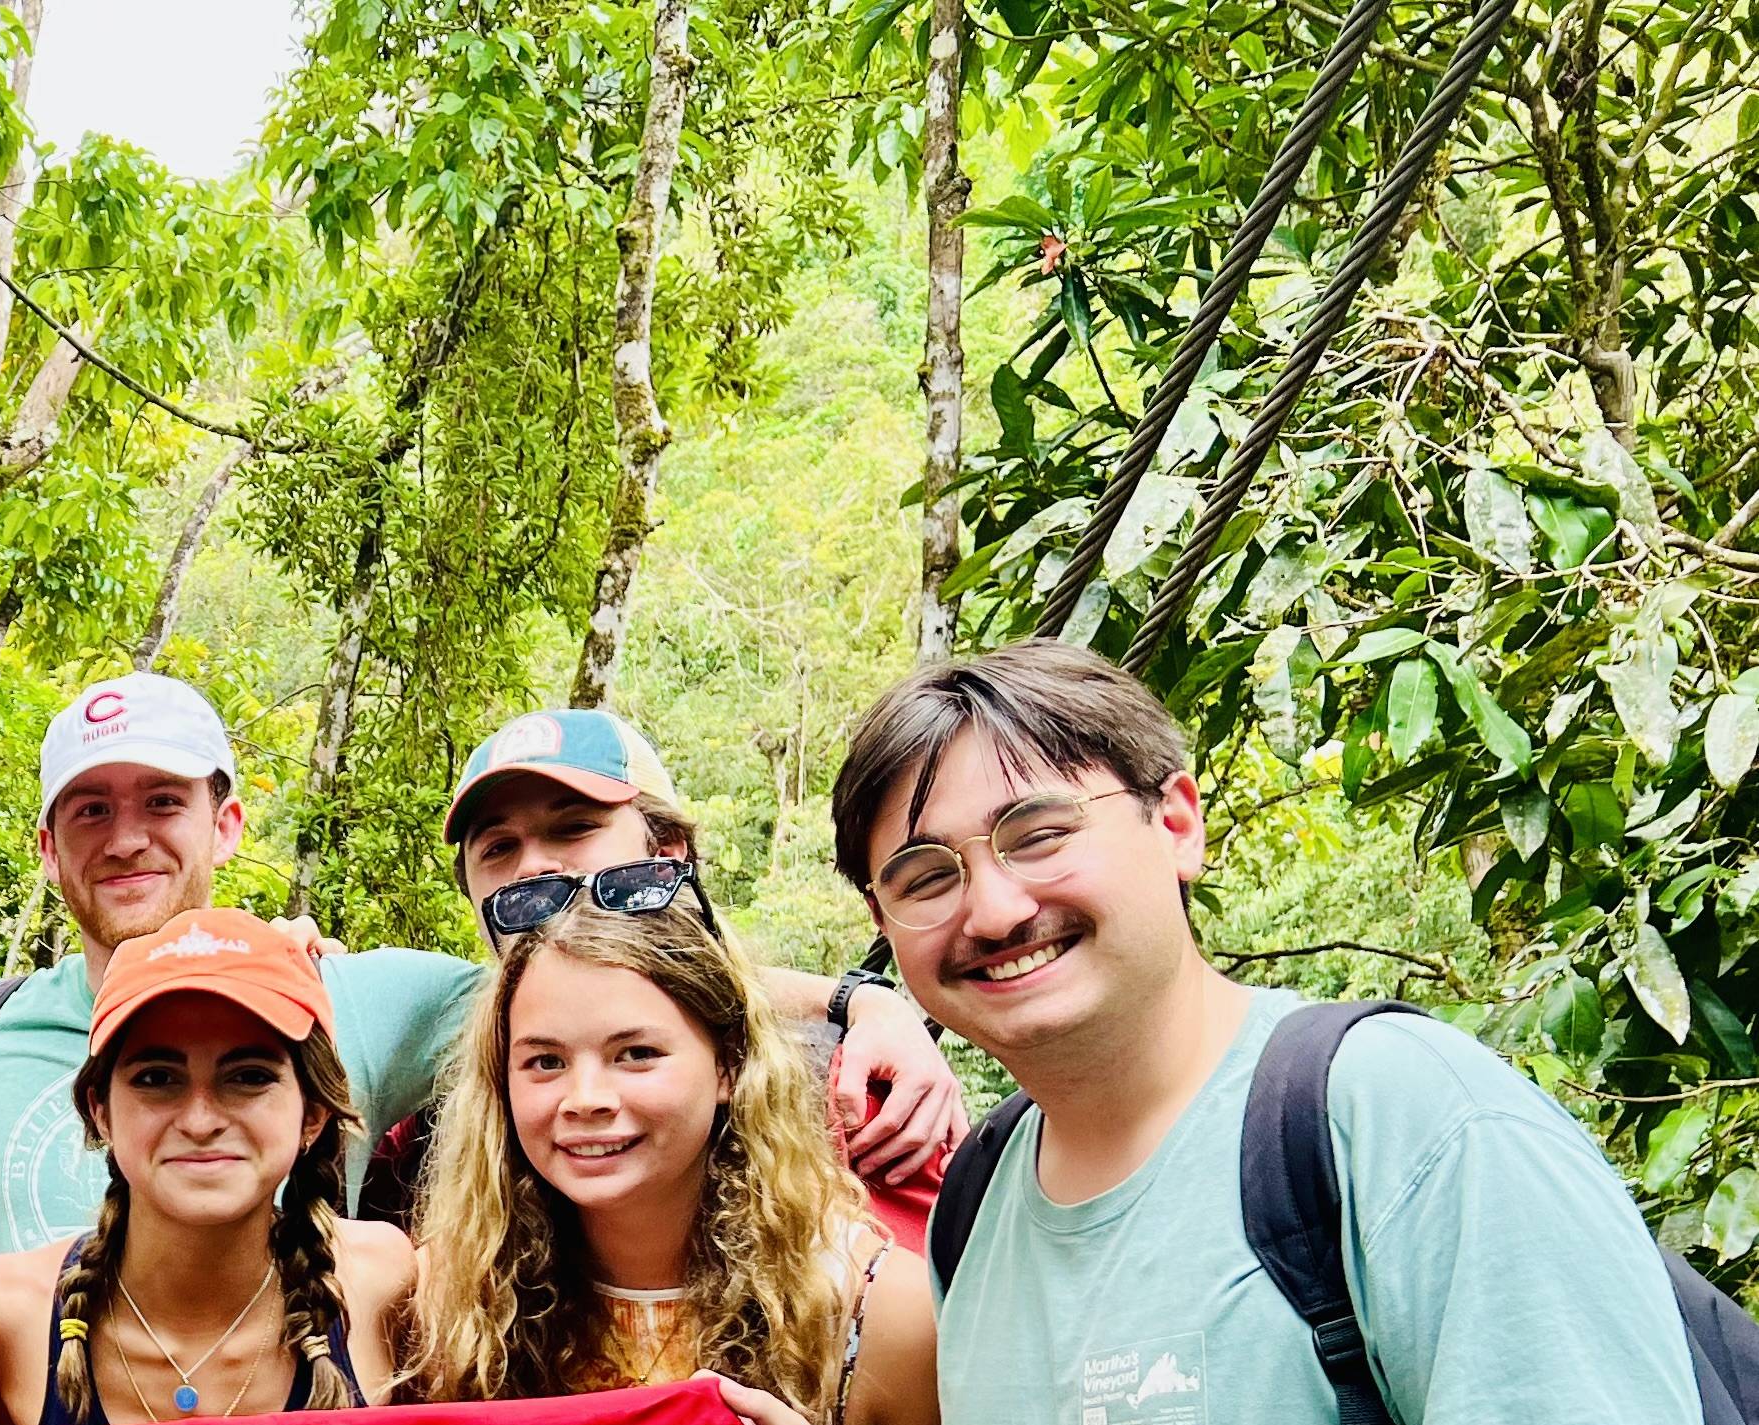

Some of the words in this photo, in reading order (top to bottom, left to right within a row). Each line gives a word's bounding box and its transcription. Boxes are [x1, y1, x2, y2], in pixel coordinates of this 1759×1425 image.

[85, 691, 127, 722] C
[83, 722, 129, 744] RUGBY
[1085, 1350, 1139, 1375] Martha's
[1084, 1367, 1139, 1392] Vineyard
